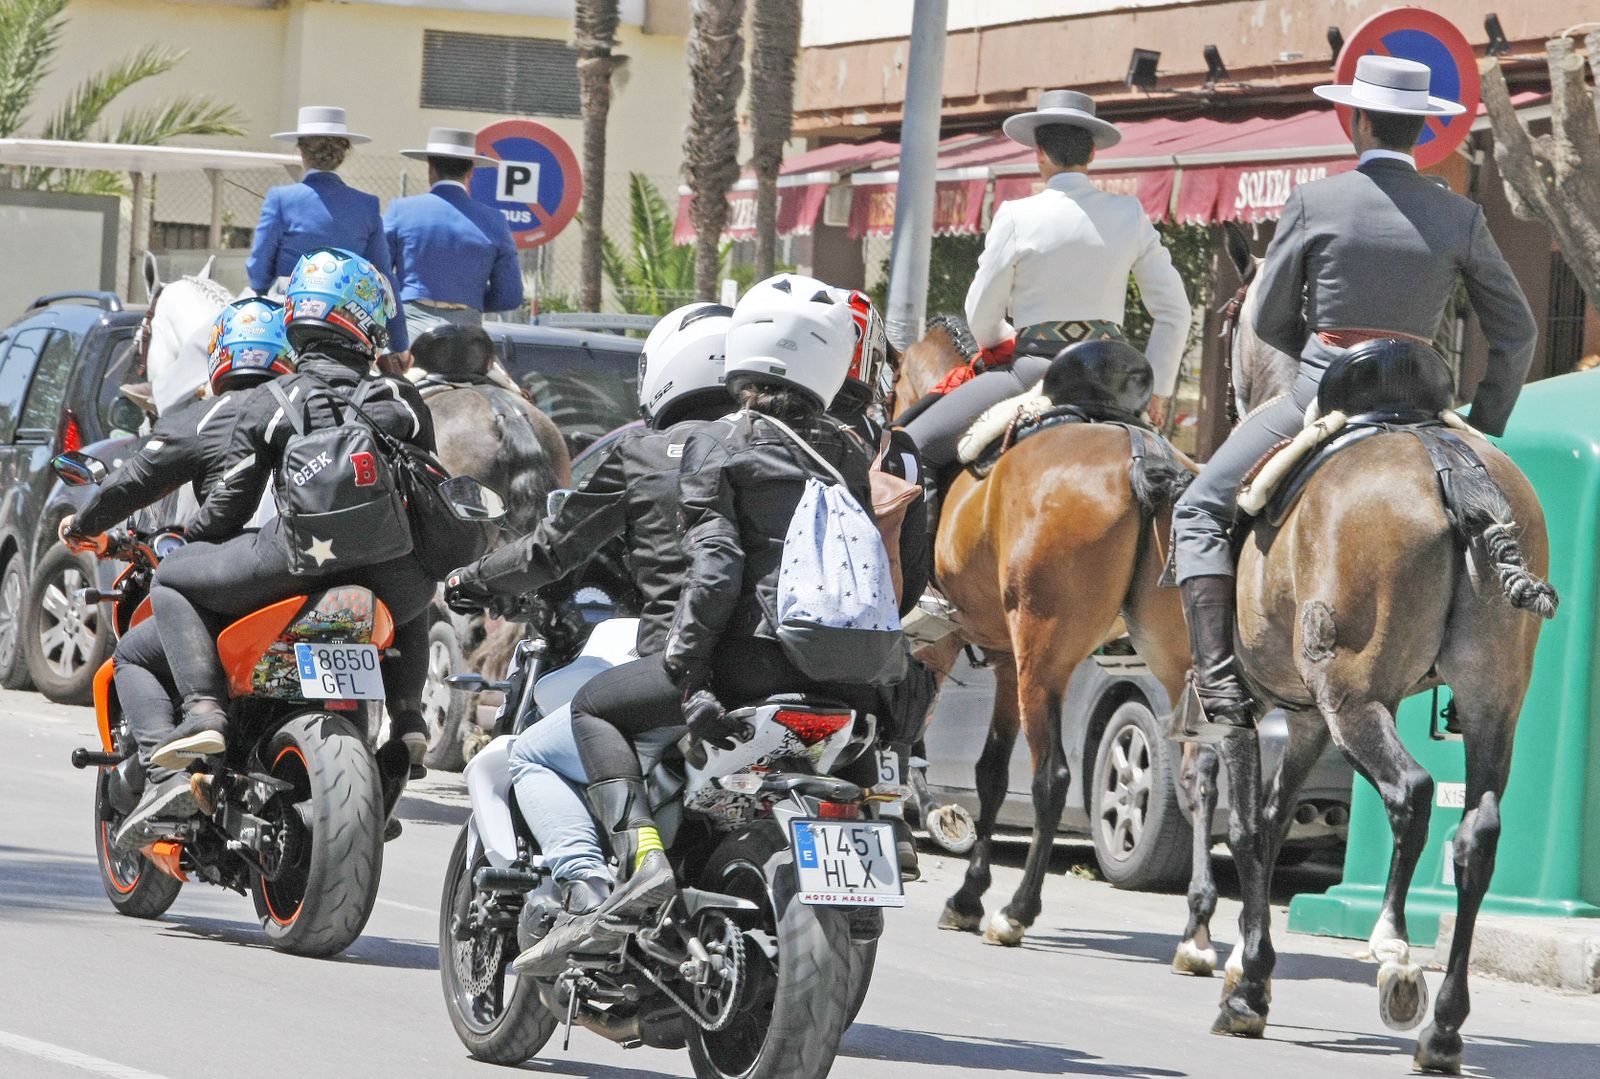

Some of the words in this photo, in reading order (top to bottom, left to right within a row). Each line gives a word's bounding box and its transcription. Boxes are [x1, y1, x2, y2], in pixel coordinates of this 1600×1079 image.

[504, 165, 532, 196] P
[650, 380, 674, 409] LS2
[292, 451, 333, 487] GEEK
[349, 451, 378, 487] B
[303, 665, 311, 674] E
[318, 649, 375, 671] 8650
[321, 673, 365, 695] GFL
[803, 850, 813, 861] E
[819, 827, 883, 857] 1451
[823, 859, 876, 889] HLX
